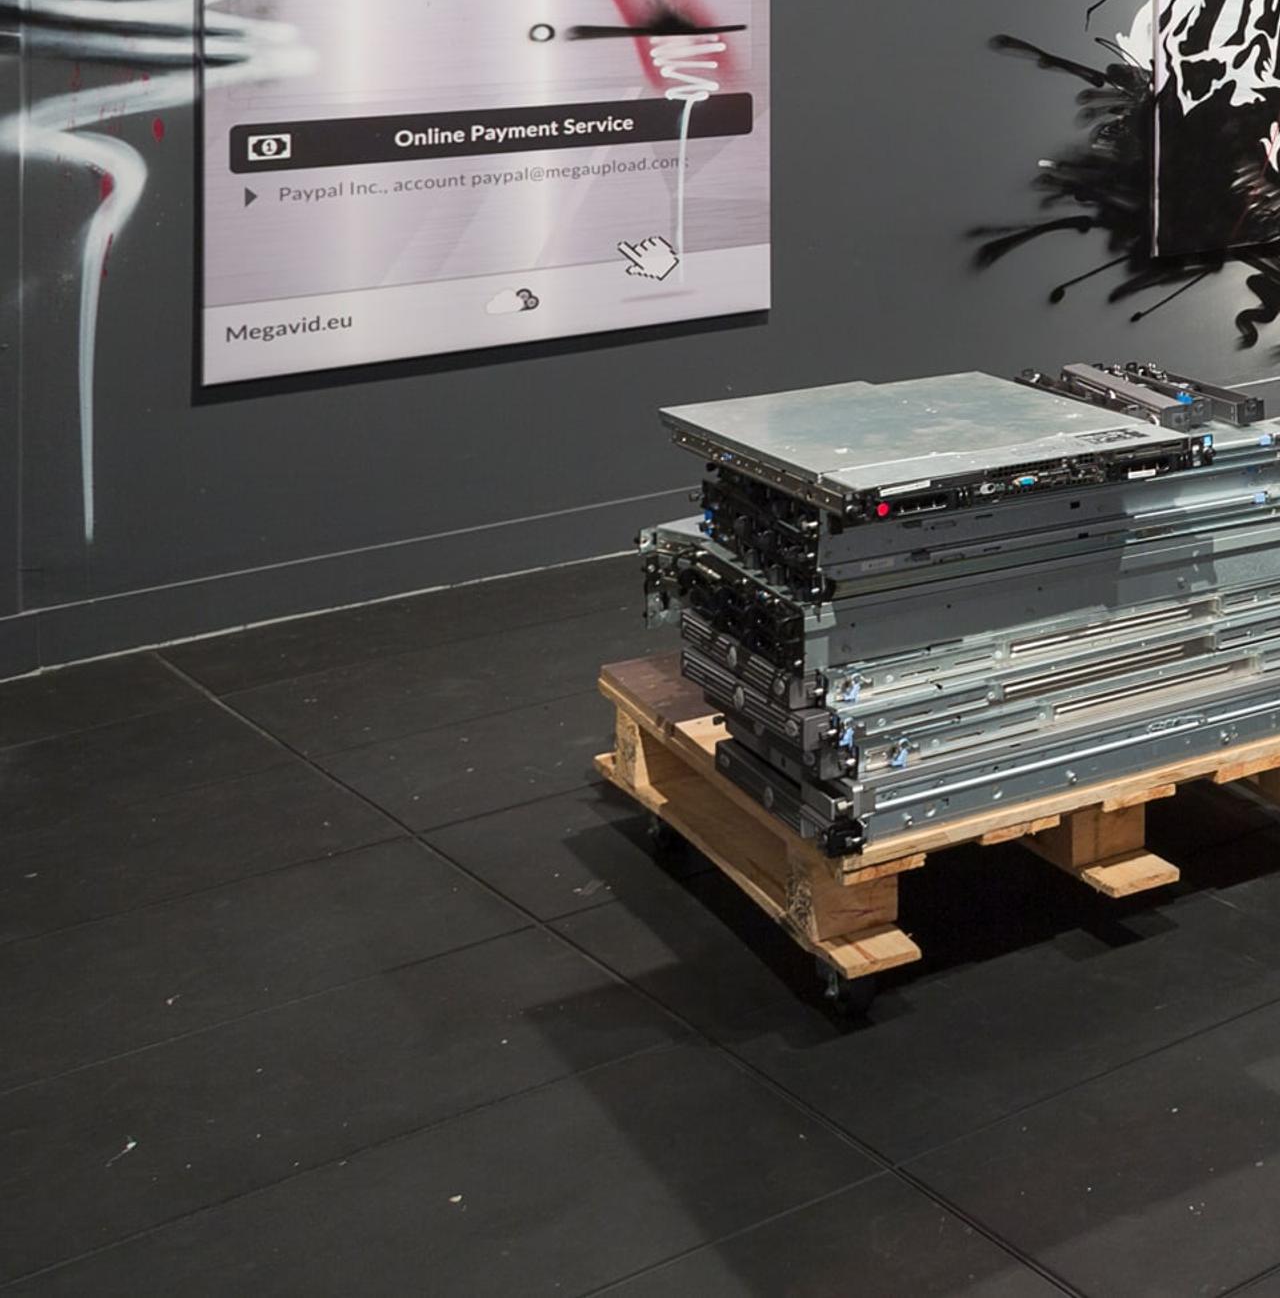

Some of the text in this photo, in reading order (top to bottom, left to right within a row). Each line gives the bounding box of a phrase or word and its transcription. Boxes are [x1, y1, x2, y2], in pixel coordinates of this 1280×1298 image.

[394, 115, 635, 148] Online Payment Service
[279, 181, 344, 202] Paypal
[350, 180, 388, 195] Inc.,
[393, 173, 466, 193] account
[225, 315, 353, 343] Megavid.eu
